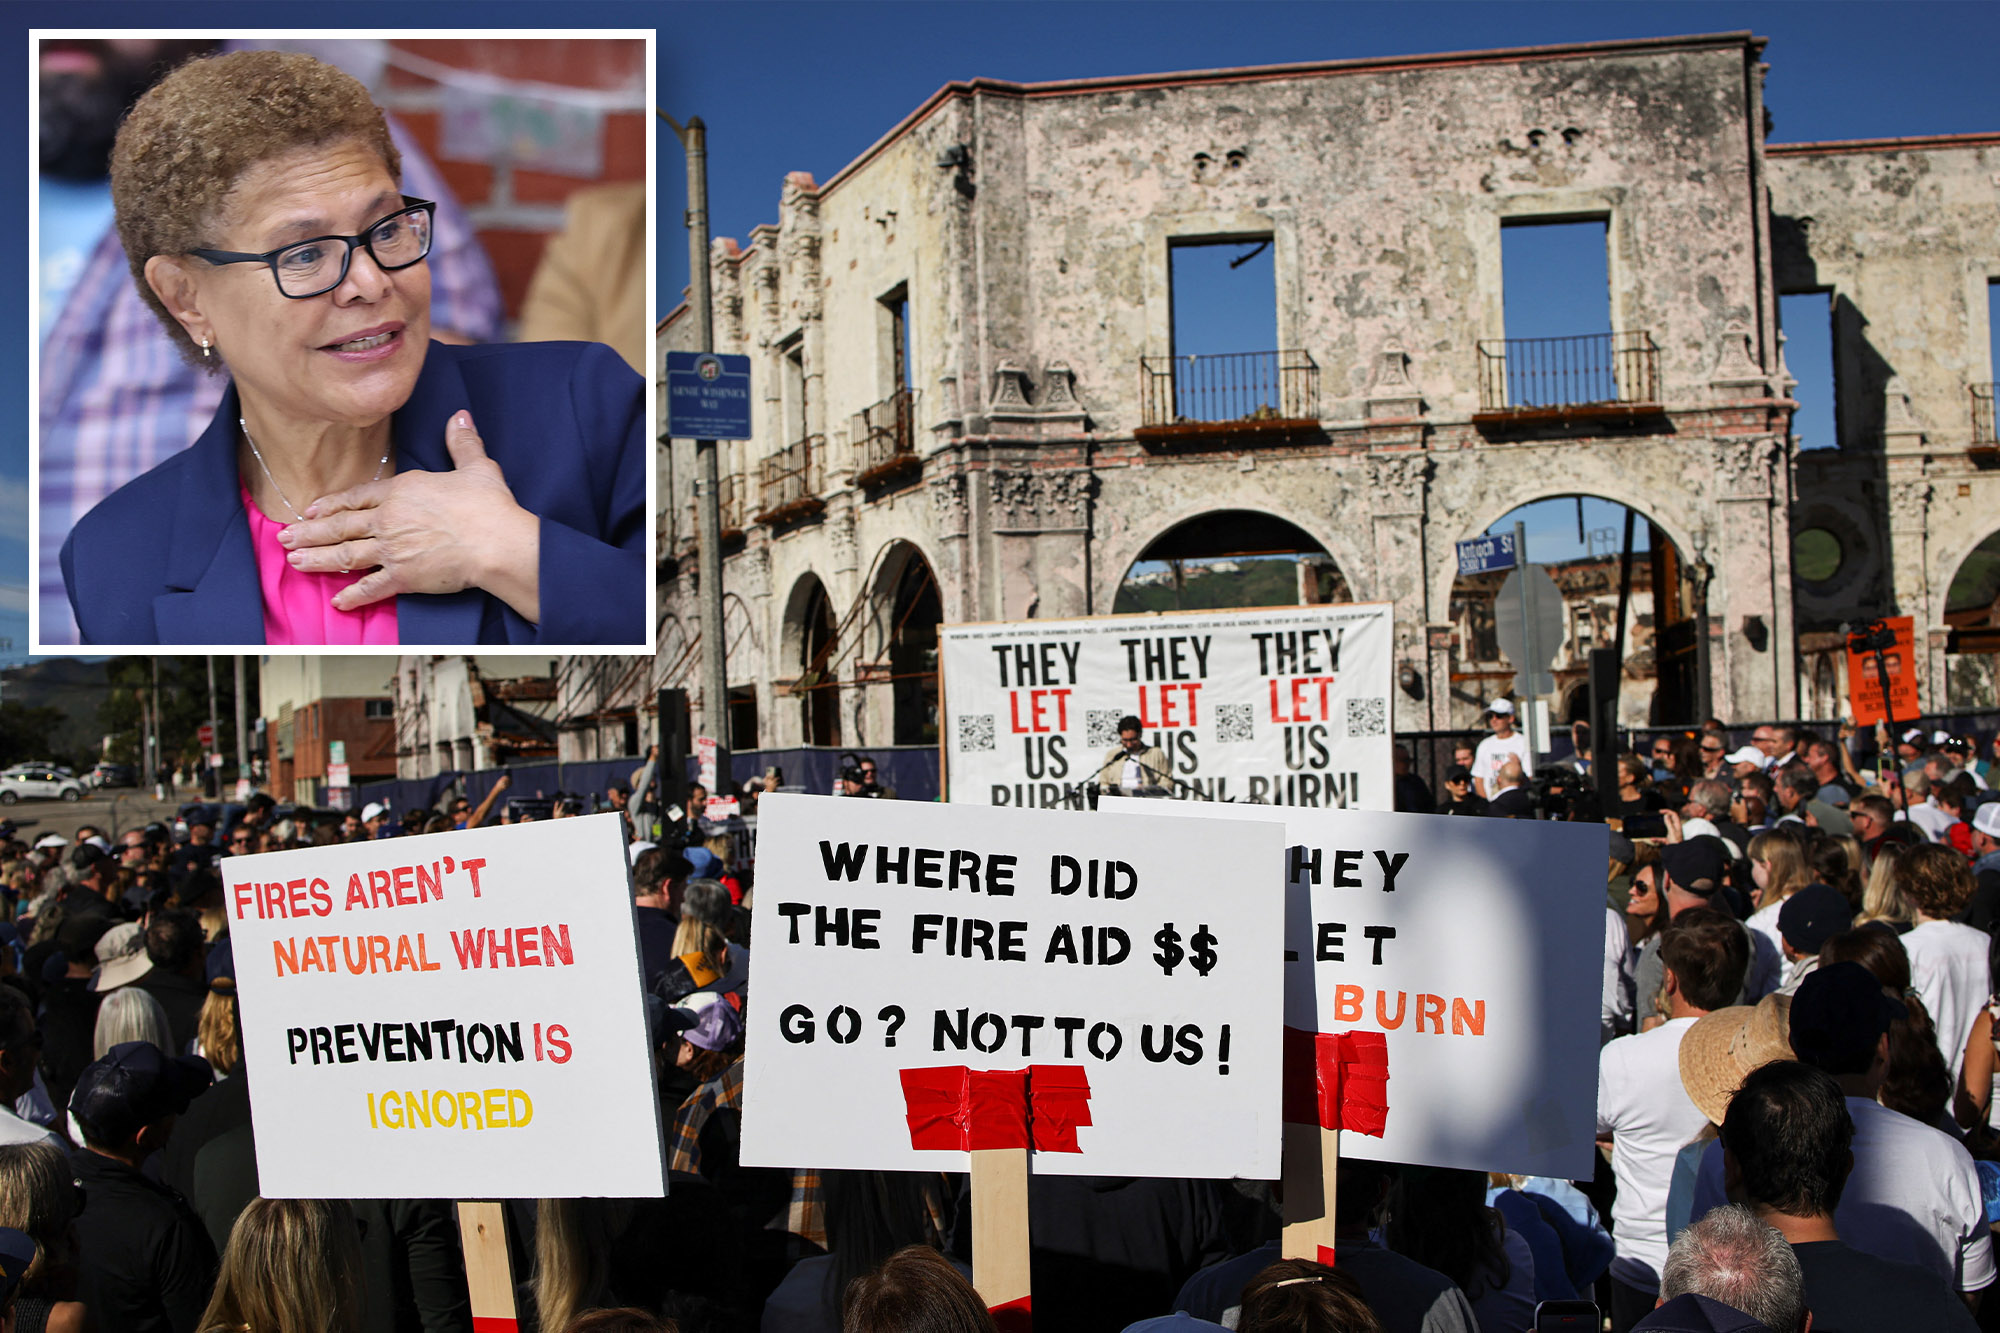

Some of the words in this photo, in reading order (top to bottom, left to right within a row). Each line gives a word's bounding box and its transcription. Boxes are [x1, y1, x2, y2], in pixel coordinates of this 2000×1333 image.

[1501, 535, 1513, 554] St
[992, 642, 1081, 688] THEY
[1120, 635, 1212, 682] THEY
[1251, 628, 1344, 676] THEY
[1010, 689, 1071, 733] LET
[1139, 683, 1202, 728] LET
[1270, 677, 1334, 723] LET
[1025, 735, 1068, 779] US
[1284, 725, 1330, 771] US
[234, 878, 332, 919] FIRES
[345, 856, 486, 911] AREN'T
[819, 841, 1017, 896] WHERE
[1051, 855, 1137, 900] DID
[1290, 846, 1409, 892] HEY
[273, 932, 441, 977] NATURAL
[450, 924, 574, 970] WHEN
[778, 903, 881, 949] THE
[912, 914, 1028, 961] FIRE
[1045, 924, 1131, 965] AID
[1153, 923, 1218, 977] $$
[1285, 923, 1396, 965] ET
[1334, 984, 1485, 1035] BURN
[287, 1019, 525, 1065] PREVENTION
[533, 1022, 573, 1064] IS
[933, 1007, 1044, 1057] NOT
[1055, 1017, 1123, 1062] TO
[367, 1089, 533, 1130] IGNORED
